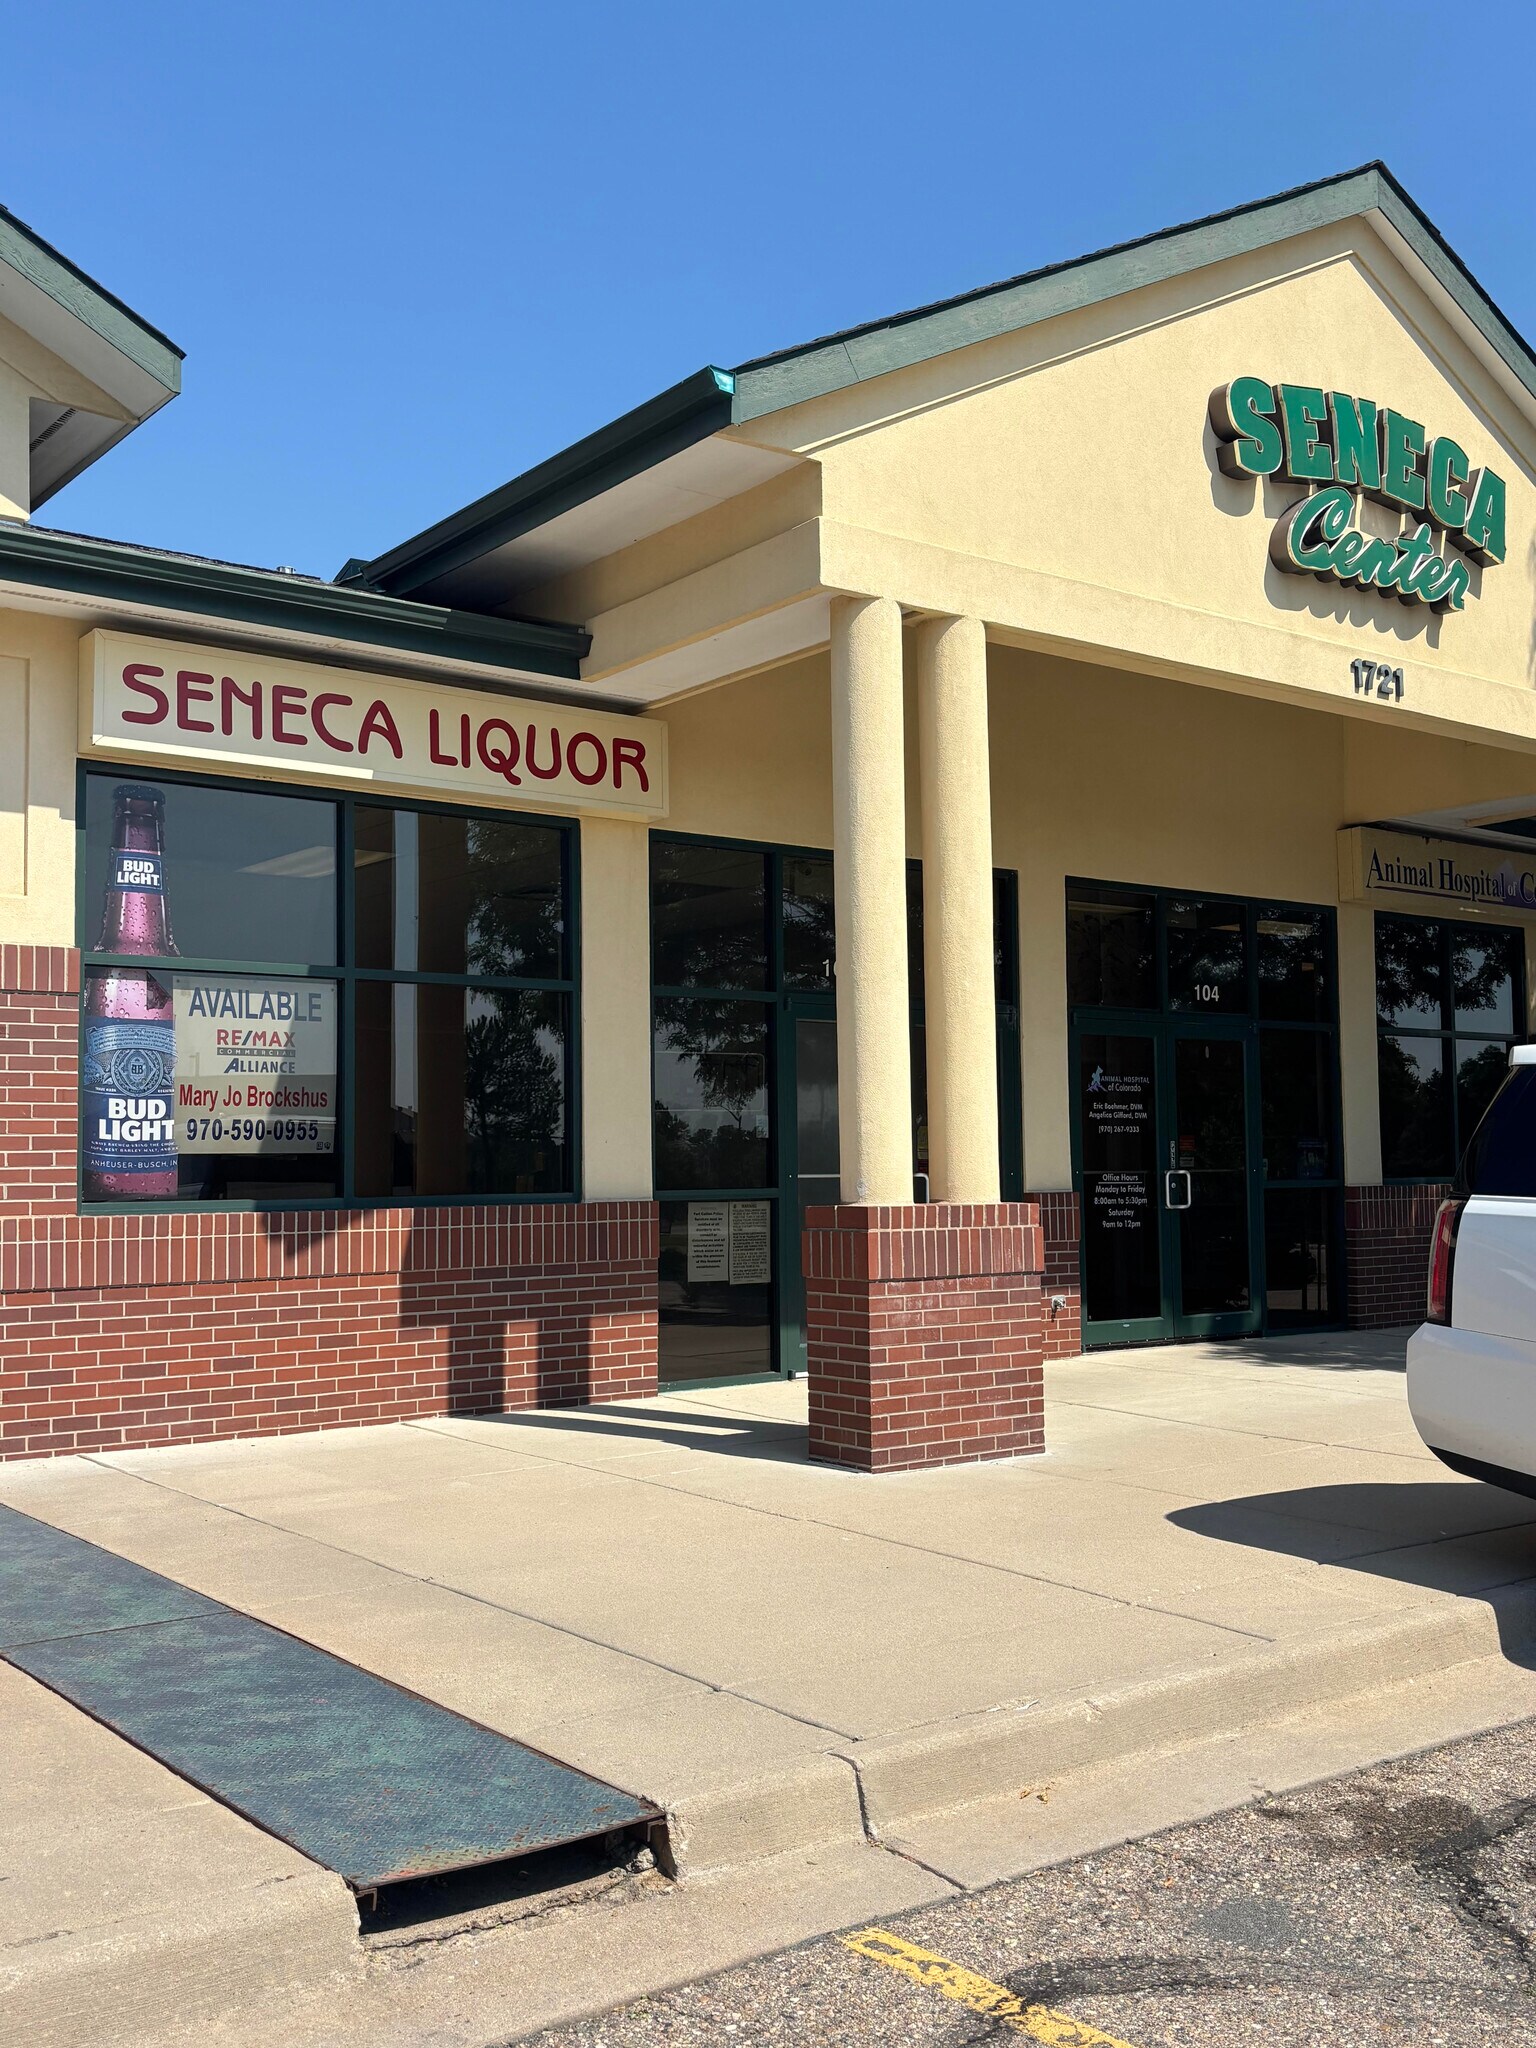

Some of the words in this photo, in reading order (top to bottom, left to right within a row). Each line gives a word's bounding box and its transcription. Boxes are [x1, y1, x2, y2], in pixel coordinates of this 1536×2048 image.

[1216, 376, 1507, 566] SENECA
[1278, 486, 1470, 613] Center
[1351, 658, 1405, 698] 1721
[122, 663, 404, 760] SENECA
[429, 708, 650, 793] LIQUOR
[122, 859, 155, 874] BUD
[1366, 848, 1434, 889] Animal
[1438, 858, 1506, 902] Hospital
[1507, 881, 1517, 897] of
[116, 871, 160, 887] LIGHT
[1194, 984, 1220, 1002] 104
[188, 986, 322, 1023] AVAILABLE
[216, 1028, 296, 1048] RE/MAX
[218, 1048, 295, 1057] COMMERCIAL
[223, 1057, 296, 1074] ALLIANCE
[1101, 1075, 1122, 1083] ANIMAL
[1123, 1076, 1150, 1084] HOSPITAL
[1107, 1083, 1115, 1091] of
[1115, 1083, 1142, 1092] Colorado
[179, 1083, 219, 1112] Mary
[222, 1084, 242, 1108] Jo
[247, 1085, 328, 1108] Brockshus
[1093, 1102, 1103, 1110] Eric
[108, 1098, 167, 1120] BUD
[98, 1118, 175, 1142] LIGHT
[186, 1118, 319, 1141] 970-590-0955
[1102, 1173, 1120, 1181] Office
[1095, 1185, 1120, 1195] Monday
[1127, 1185, 1146, 1194] Friday
[1093, 1196, 1117, 1205] 8:00am
[1118, 1197, 1125, 1205] to
[1125, 1196, 1148, 1206] 5:30pm
[1108, 1208, 1135, 1217] Saturday
[1102, 1220, 1116, 1228] 9am
[1116, 1220, 1123, 1228] to
[1124, 1220, 1141, 1229] 12pm
